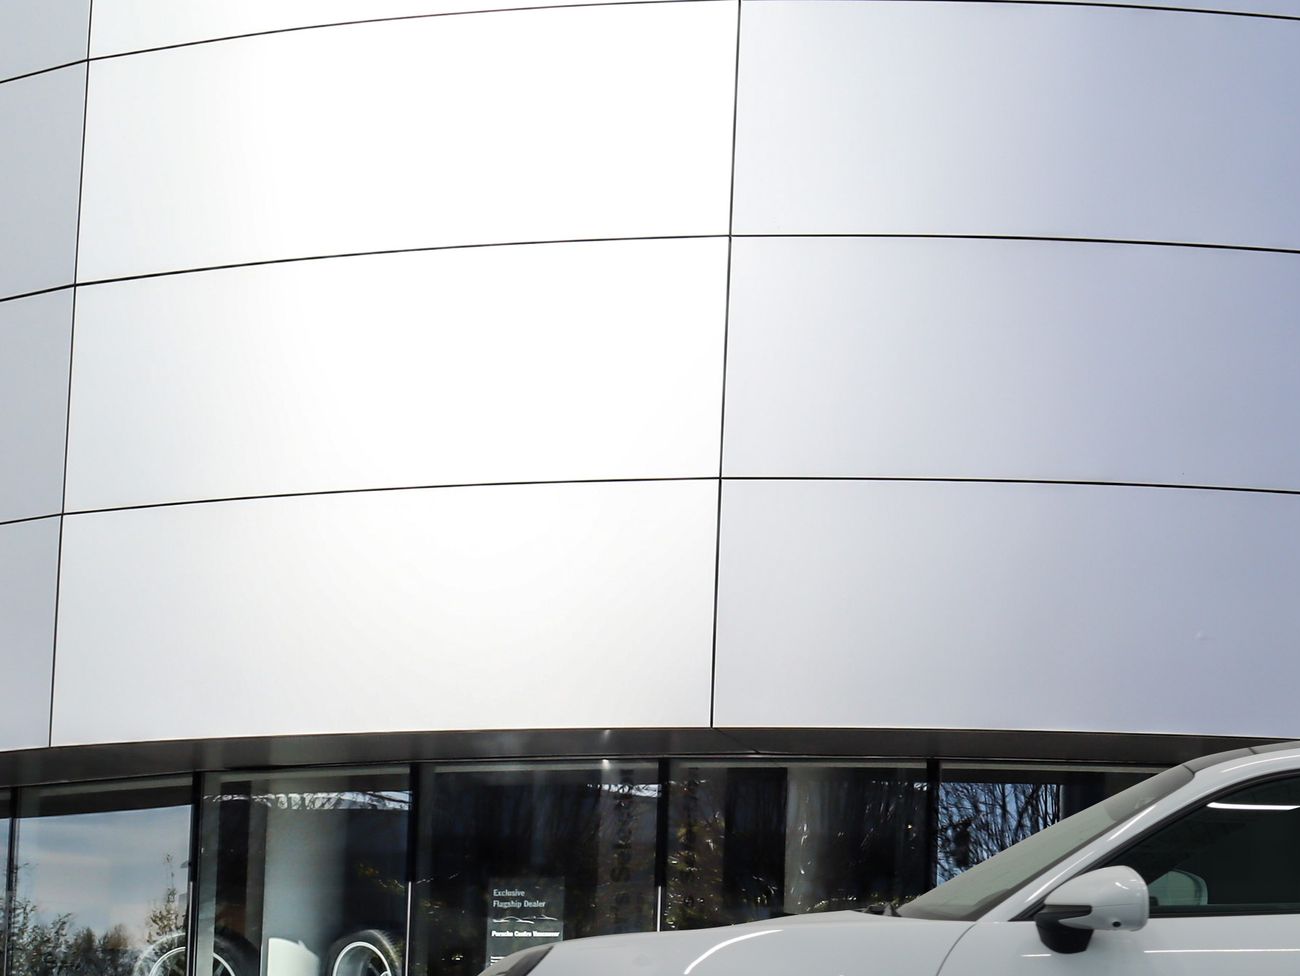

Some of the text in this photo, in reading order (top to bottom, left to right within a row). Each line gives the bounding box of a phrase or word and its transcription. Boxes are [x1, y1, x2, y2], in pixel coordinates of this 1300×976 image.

[493, 888, 525, 897] Exclusive
[493, 899, 546, 909] Flagship Dealer
